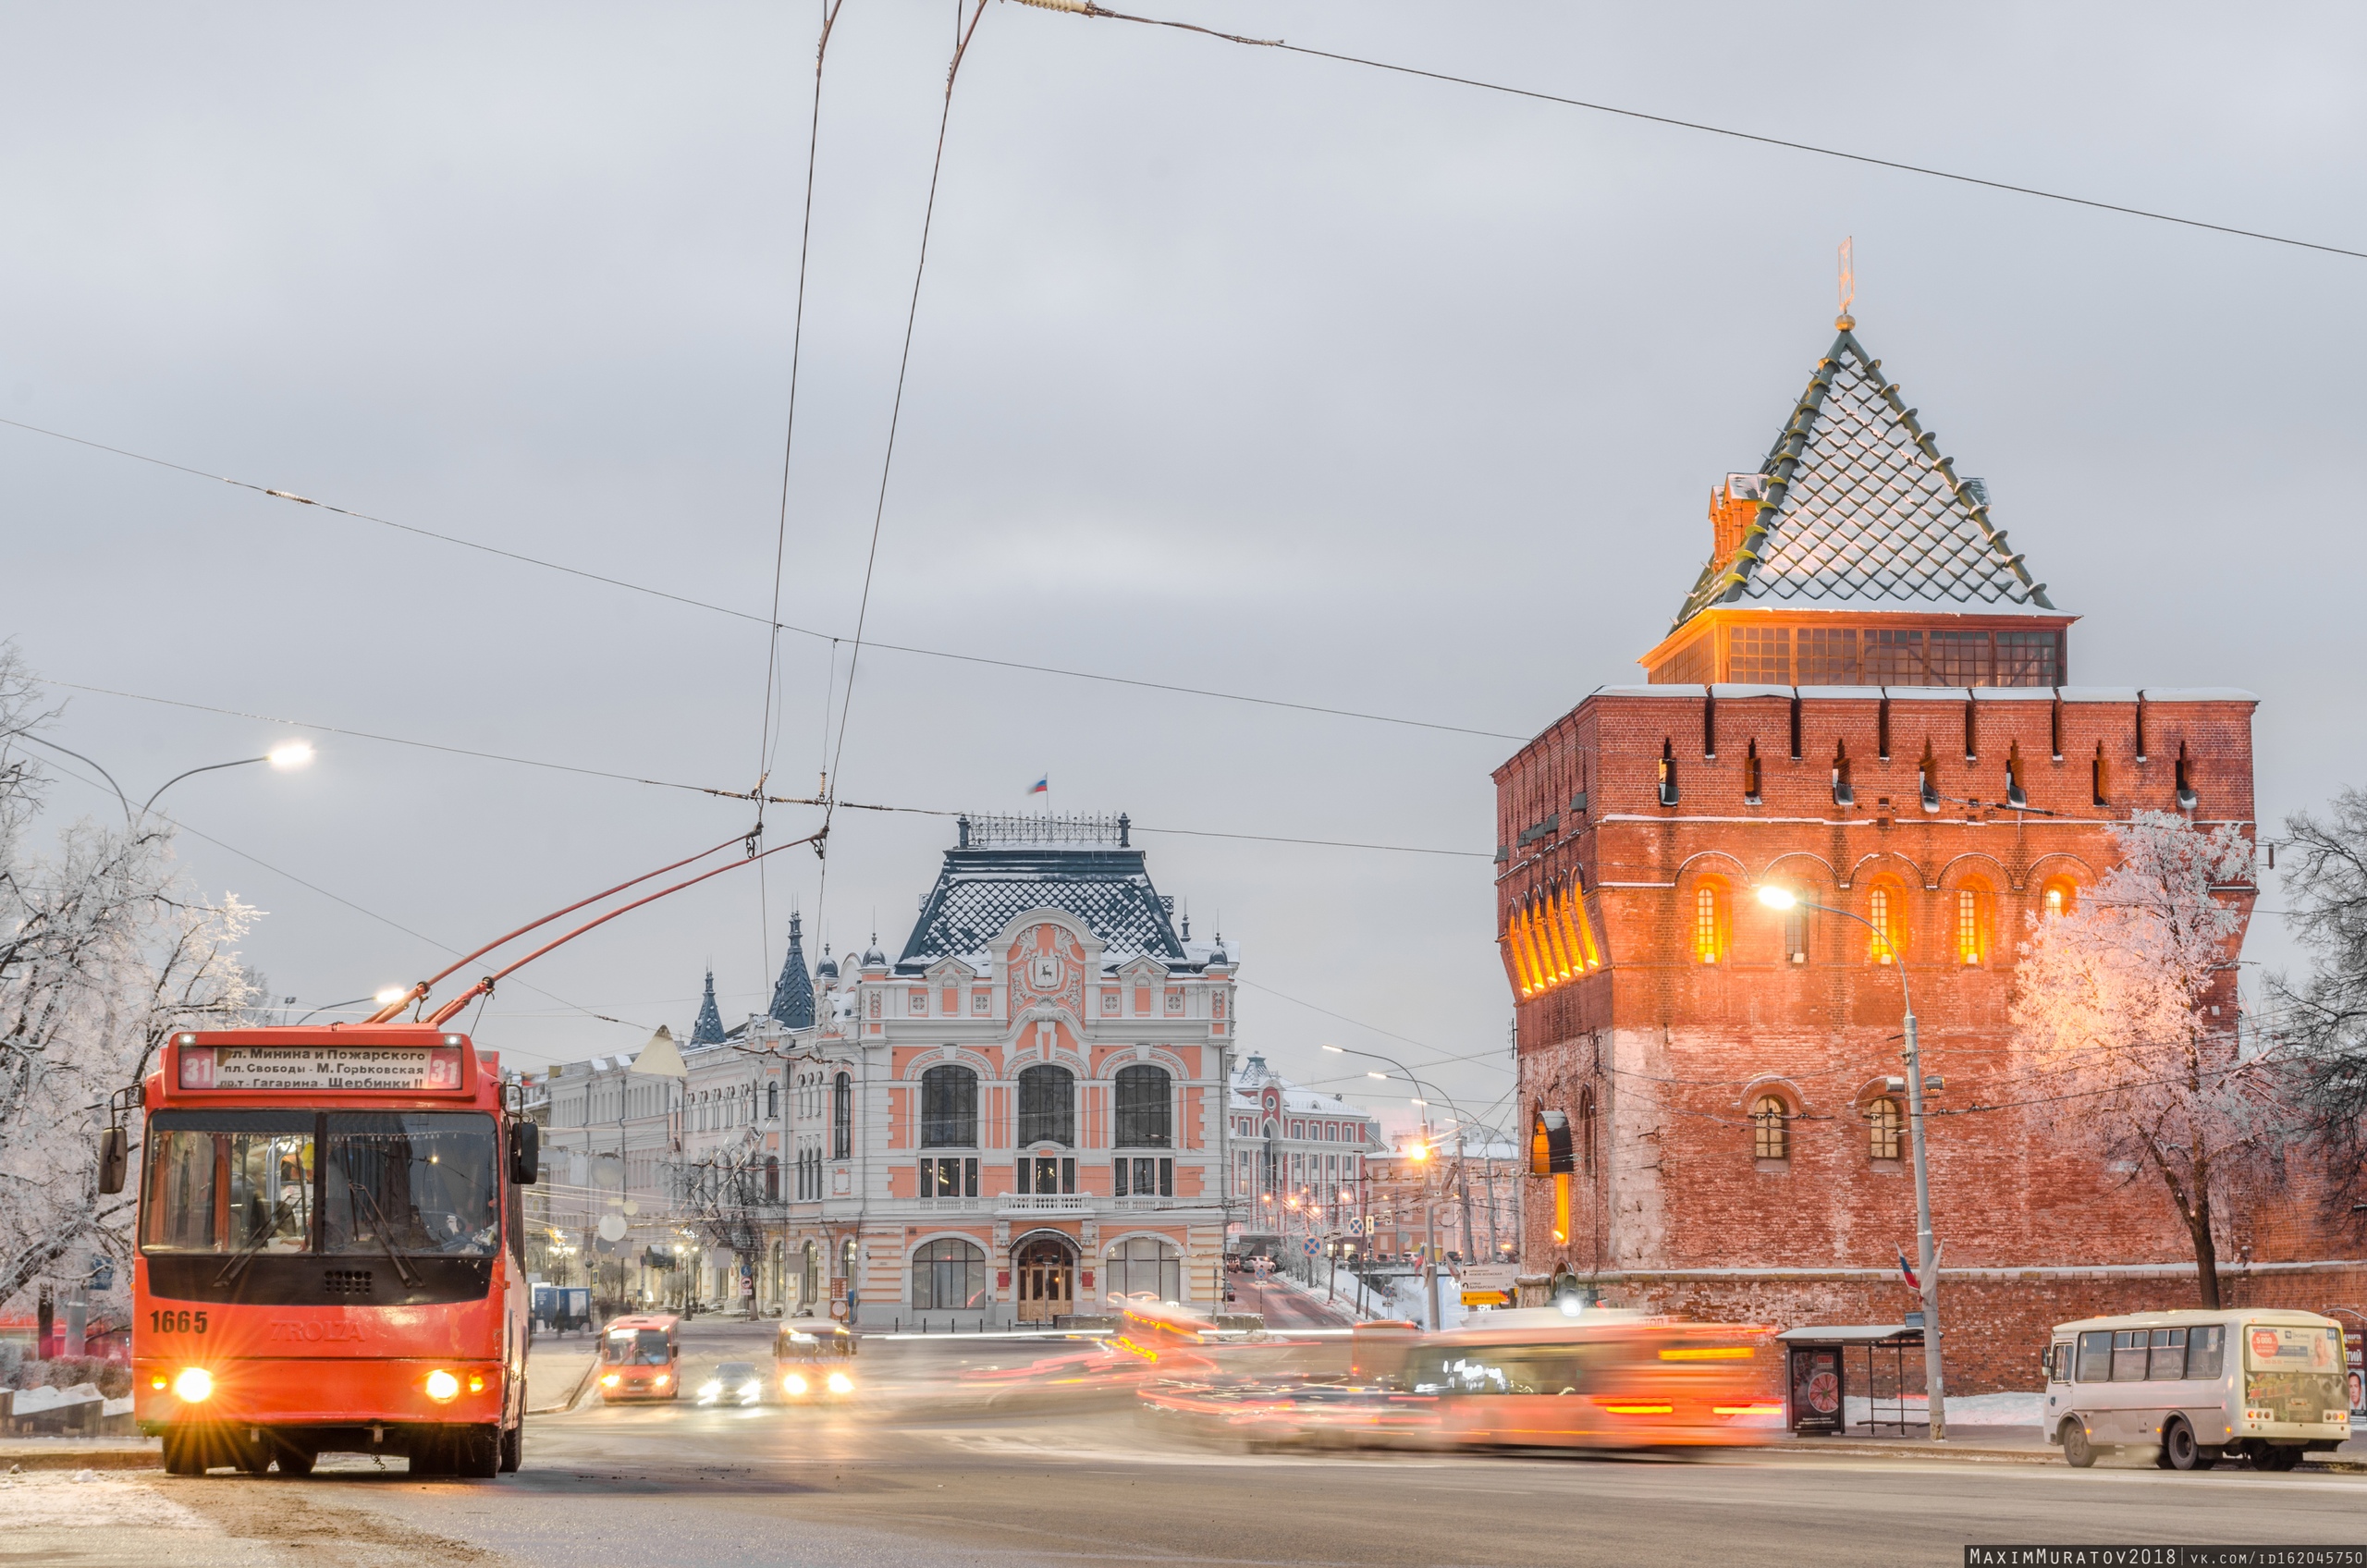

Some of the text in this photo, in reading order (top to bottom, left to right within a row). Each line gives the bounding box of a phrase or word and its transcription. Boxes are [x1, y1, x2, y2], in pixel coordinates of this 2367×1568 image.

[250, 1047, 311, 1060] Минина
[314, 1050, 324, 1060] и
[327, 1049, 425, 1062] Пожарского
[185, 1058, 211, 1083] 31
[225, 1064, 244, 1073] пл.
[247, 1063, 305, 1074] Свободы
[316, 1063, 334, 1073] М.
[337, 1063, 424, 1075] Горьковская
[430, 1060, 458, 1084] 31
[252, 1078, 318, 1088] Гагарина
[328, 1077, 411, 1088] Щербинки
[150, 1309, 208, 1334] 1665
[270, 1320, 366, 1342] TROLZA
